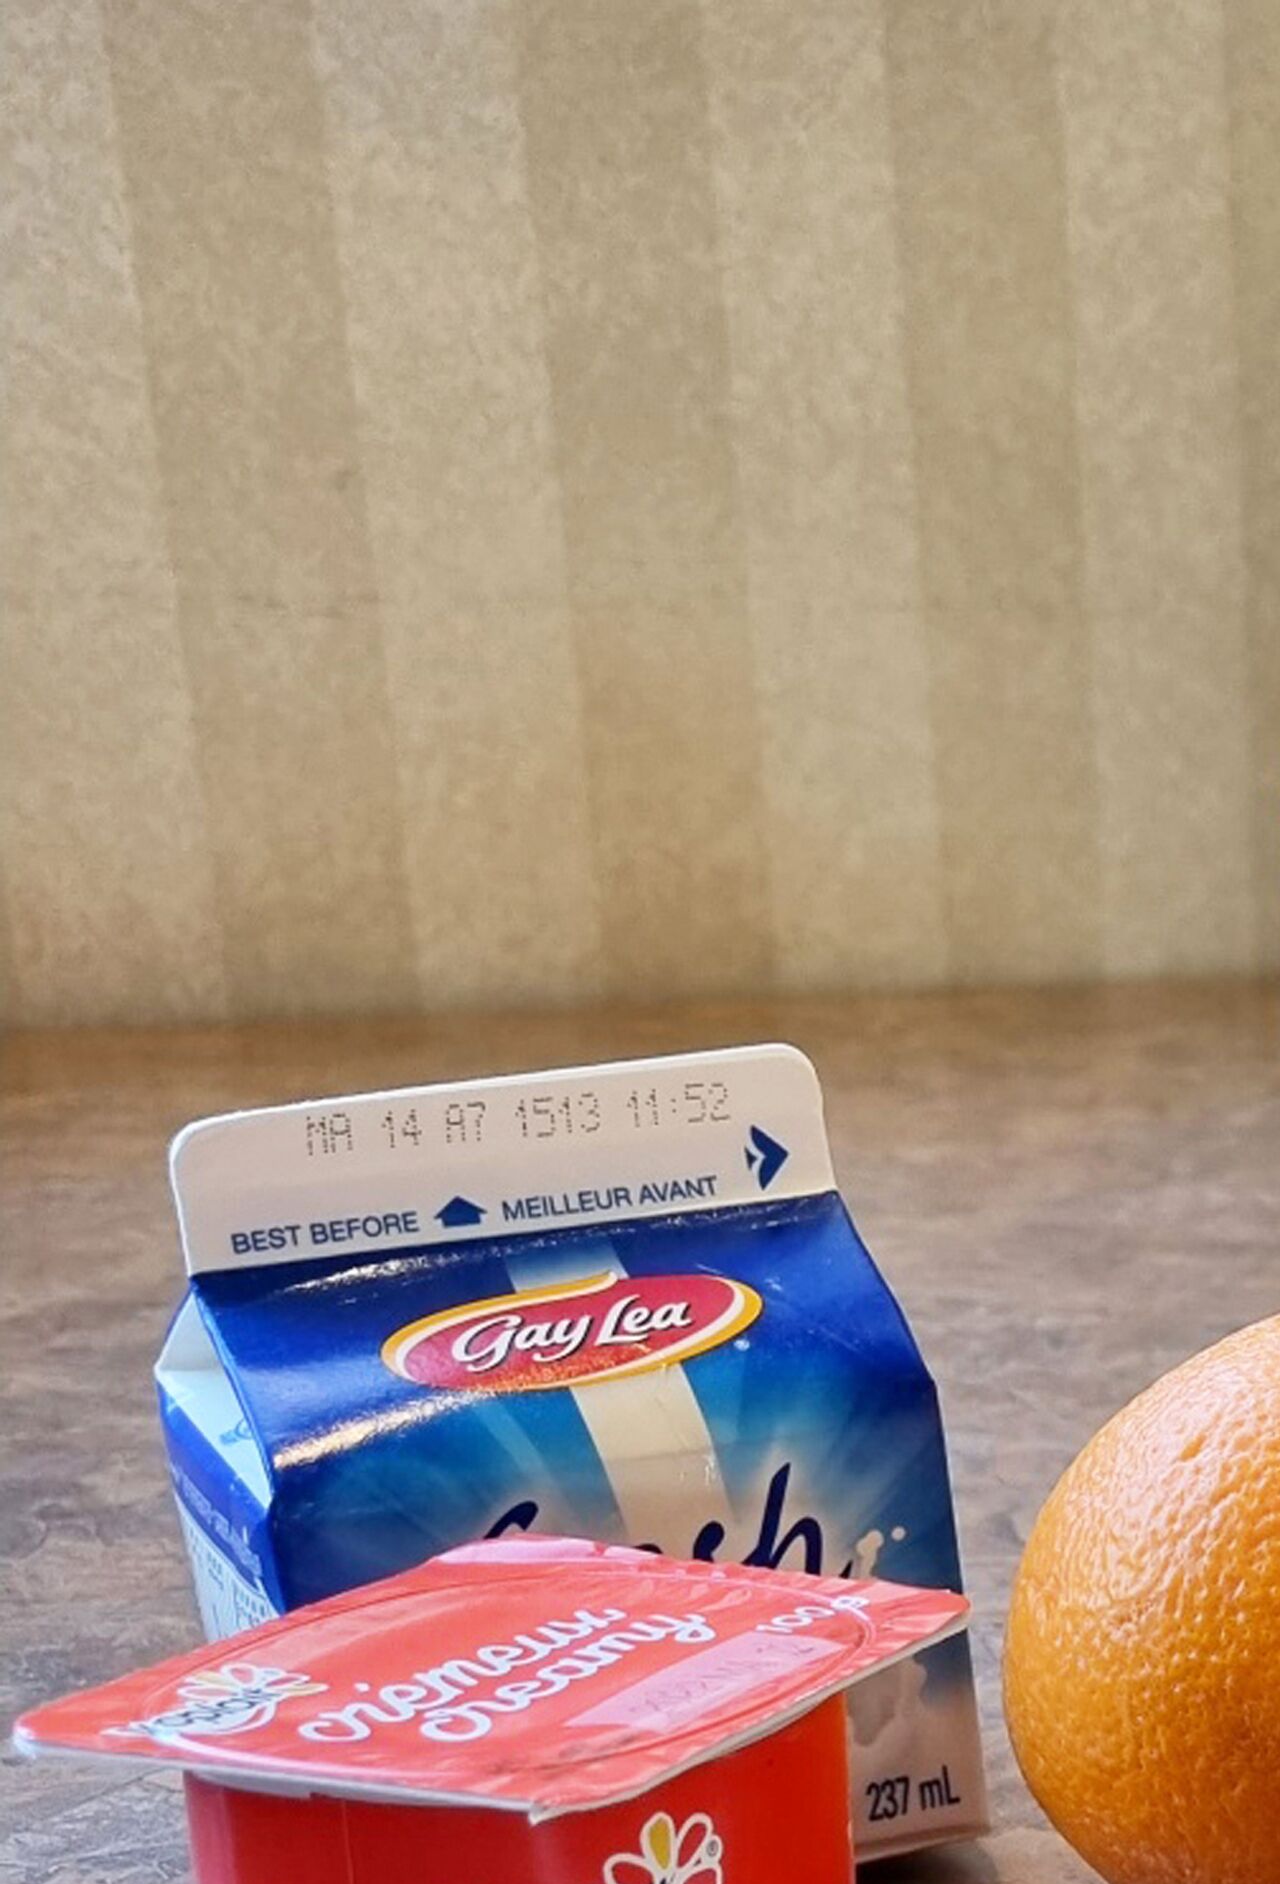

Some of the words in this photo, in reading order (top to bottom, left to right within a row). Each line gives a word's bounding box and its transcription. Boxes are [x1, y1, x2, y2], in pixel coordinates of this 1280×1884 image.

[381, 1110, 423, 1148] 14
[515, 1092, 601, 1138] 1513
[626, 1082, 731, 1129] 11:52
[231, 1224, 302, 1254] BEST
[310, 1211, 420, 1246] BEFORE
[502, 1185, 633, 1221] MEILLEUR
[638, 1175, 718, 1205] AVANT
[451, 1314, 594, 1373] Gay
[595, 1294, 693, 1347] Lea
[419, 1612, 717, 1742] creamy
[865, 1775, 910, 1822] 237
[918, 1764, 961, 1812] mL
